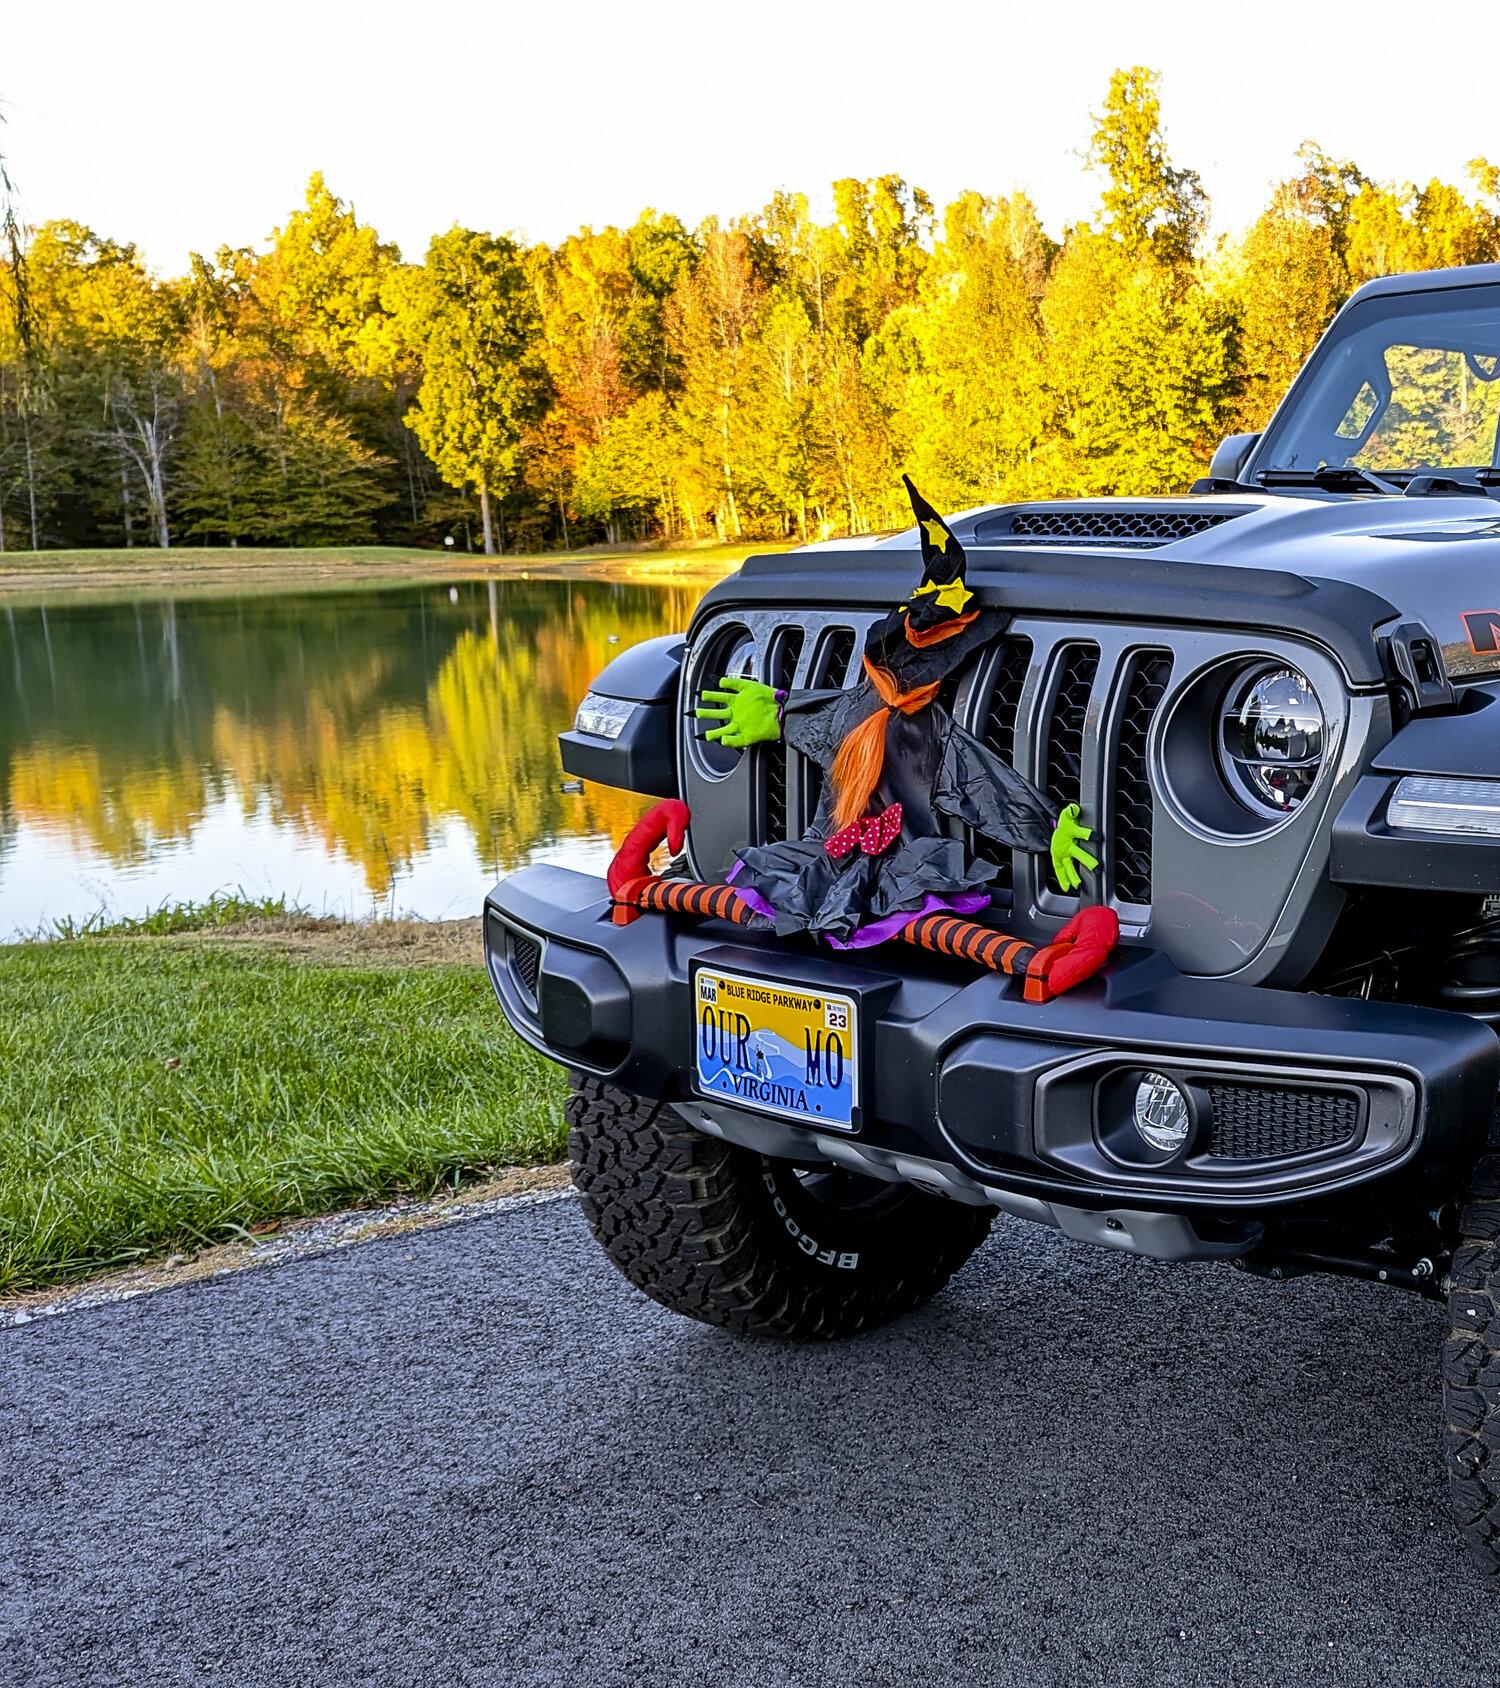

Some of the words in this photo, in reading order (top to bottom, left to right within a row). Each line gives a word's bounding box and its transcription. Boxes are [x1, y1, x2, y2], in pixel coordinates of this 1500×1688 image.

[700, 985, 717, 1002] MAR
[726, 984, 746, 999] BLUE
[746, 988, 772, 1004] RIDGE
[772, 993, 813, 1012] PARKWAY
[829, 1012, 847, 1028] 23
[702, 1005, 751, 1071] OUR
[804, 1027, 844, 1089] MO
[732, 1074, 810, 1112] VIRGINIA
